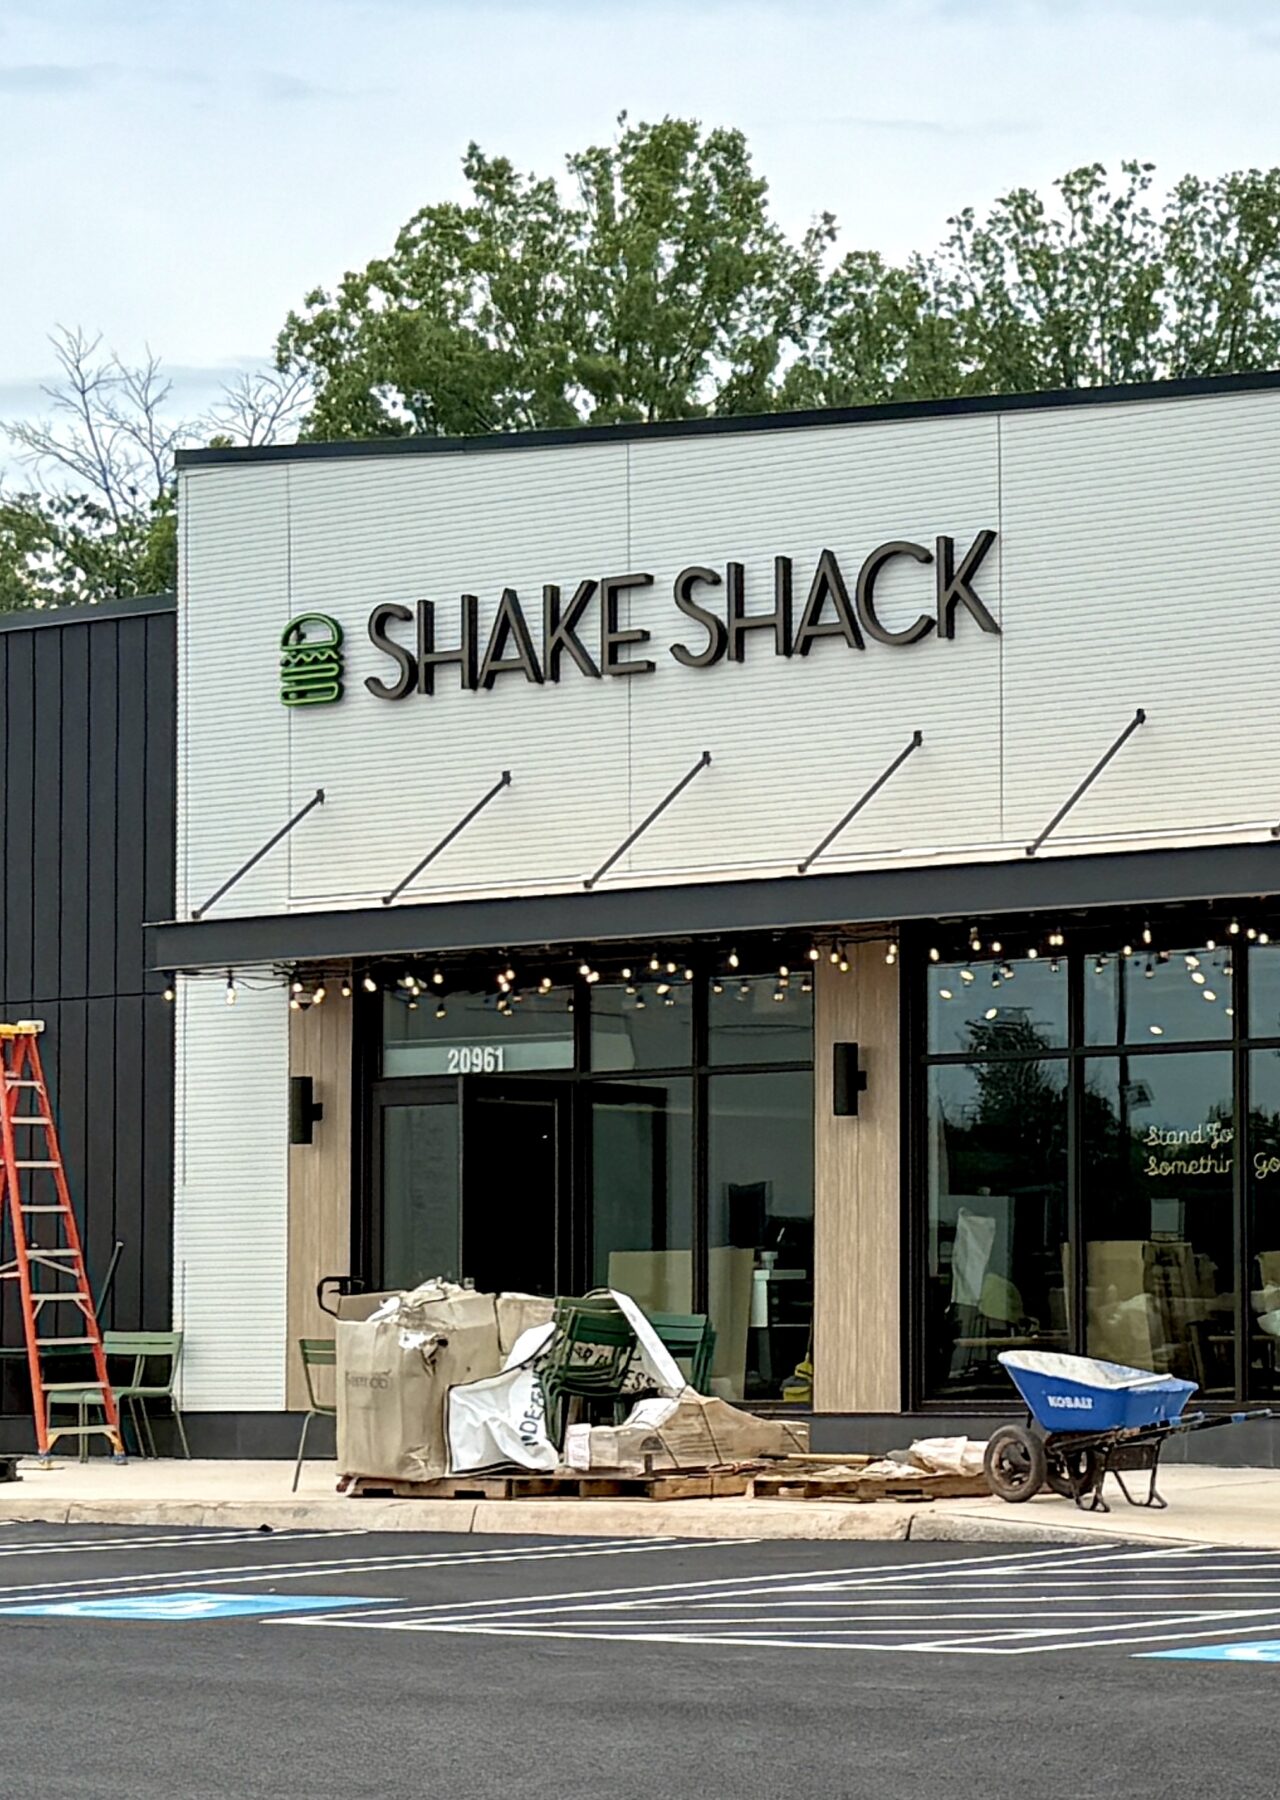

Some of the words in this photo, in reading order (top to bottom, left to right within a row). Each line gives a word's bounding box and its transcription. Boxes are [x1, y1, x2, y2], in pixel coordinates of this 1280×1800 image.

[364, 573, 656, 700] SHAKE
[670, 529, 1001, 668] SHACK
[448, 1047, 504, 1074] 20961
[1143, 1124, 1206, 1146] Stand
[1206, 1122, 1234, 1149] Fo
[1144, 1154, 1234, 1176] Somethi
[1047, 1395, 1093, 1409] KOBALT
